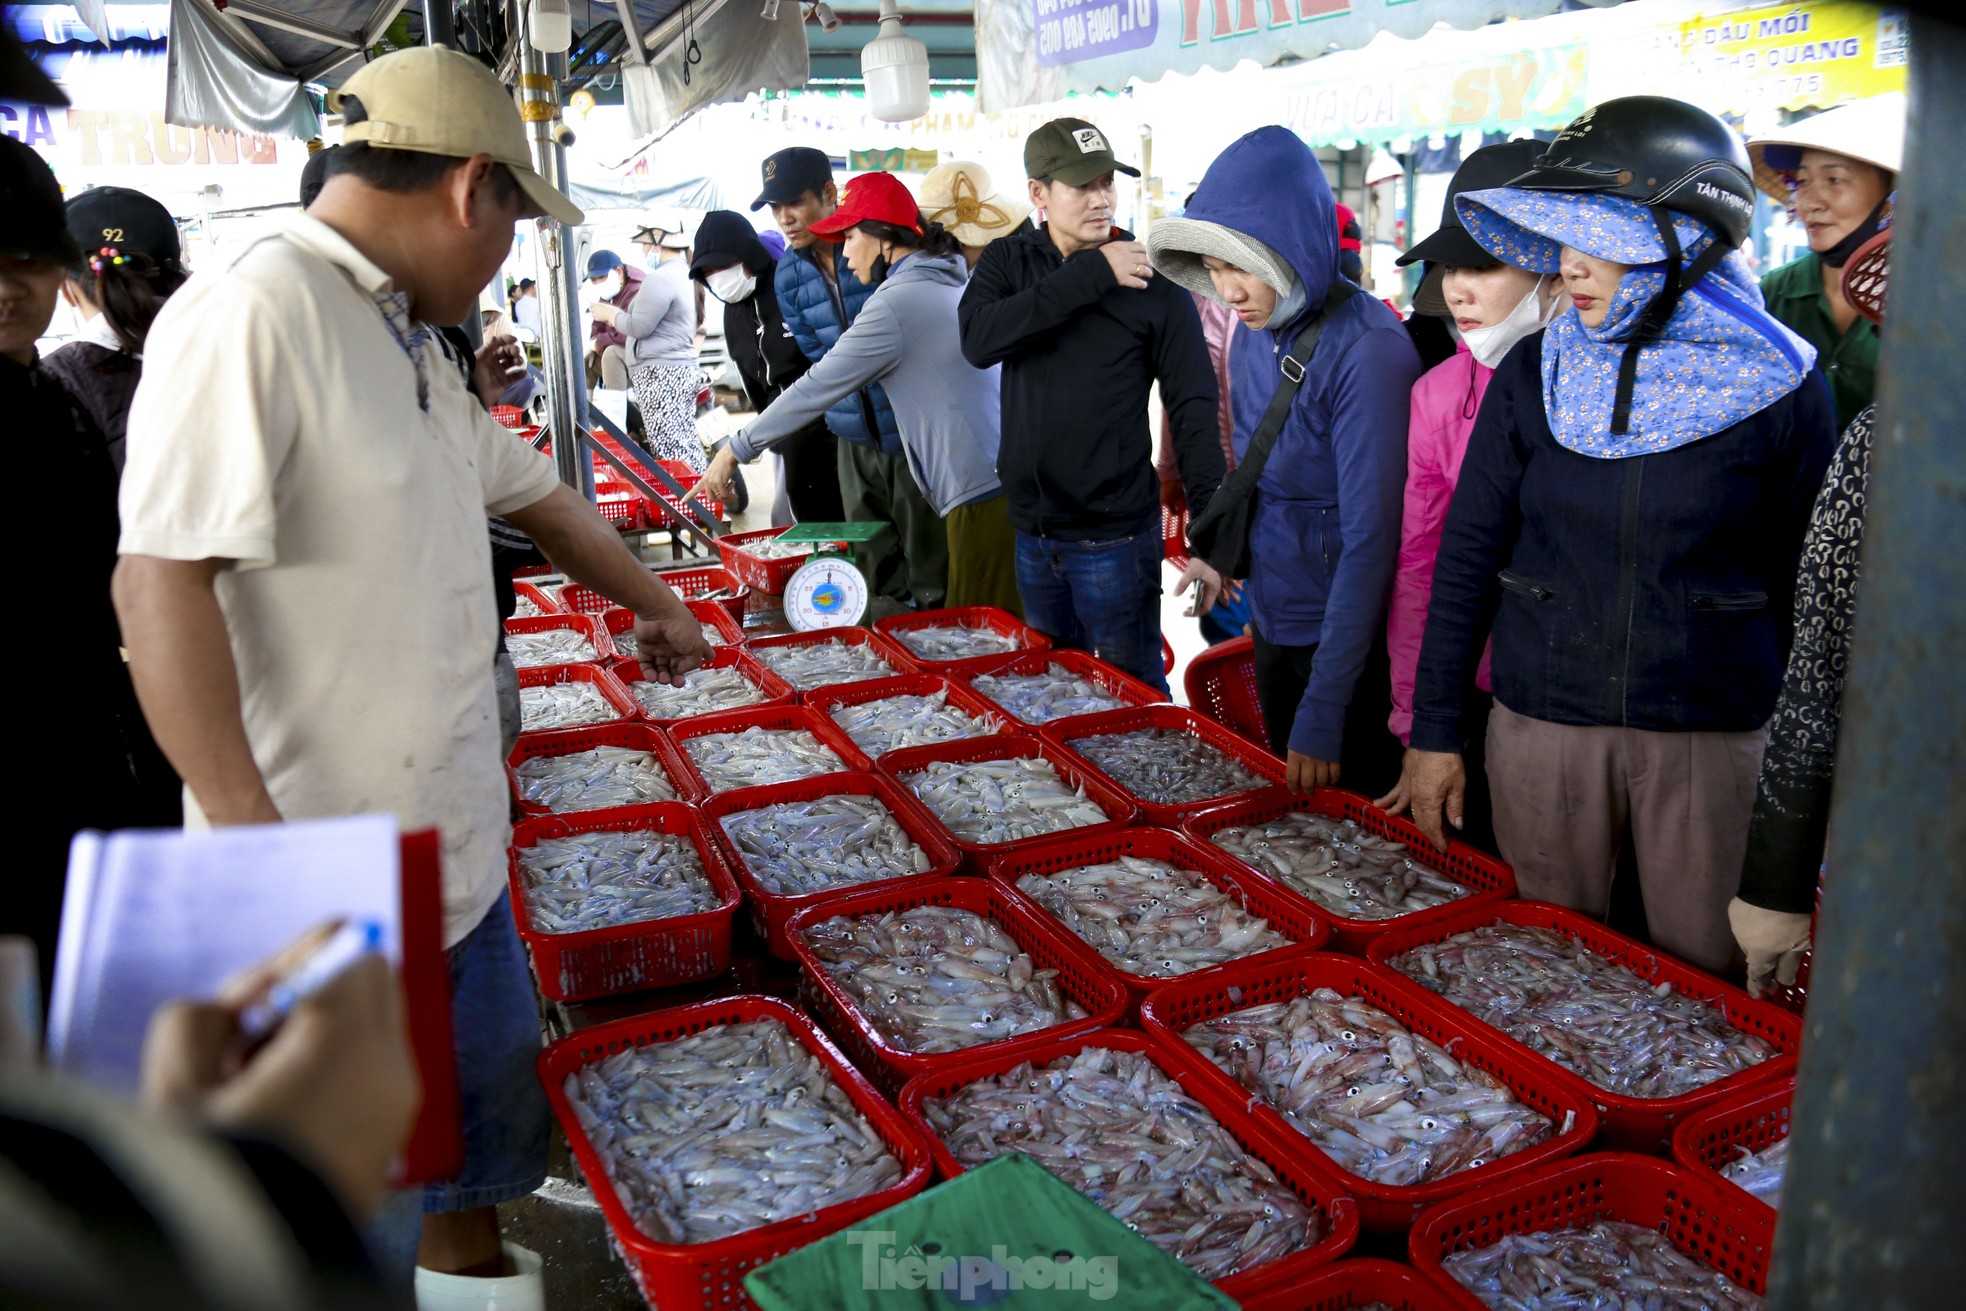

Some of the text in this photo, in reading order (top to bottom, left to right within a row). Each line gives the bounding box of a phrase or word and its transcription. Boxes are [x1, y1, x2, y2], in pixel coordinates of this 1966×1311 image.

[1759, 8, 1811, 38] MỐI
[1767, 38, 1860, 67] QUANG
[1697, 182, 1719, 198] TÂN
[102, 228, 125, 242] 92
